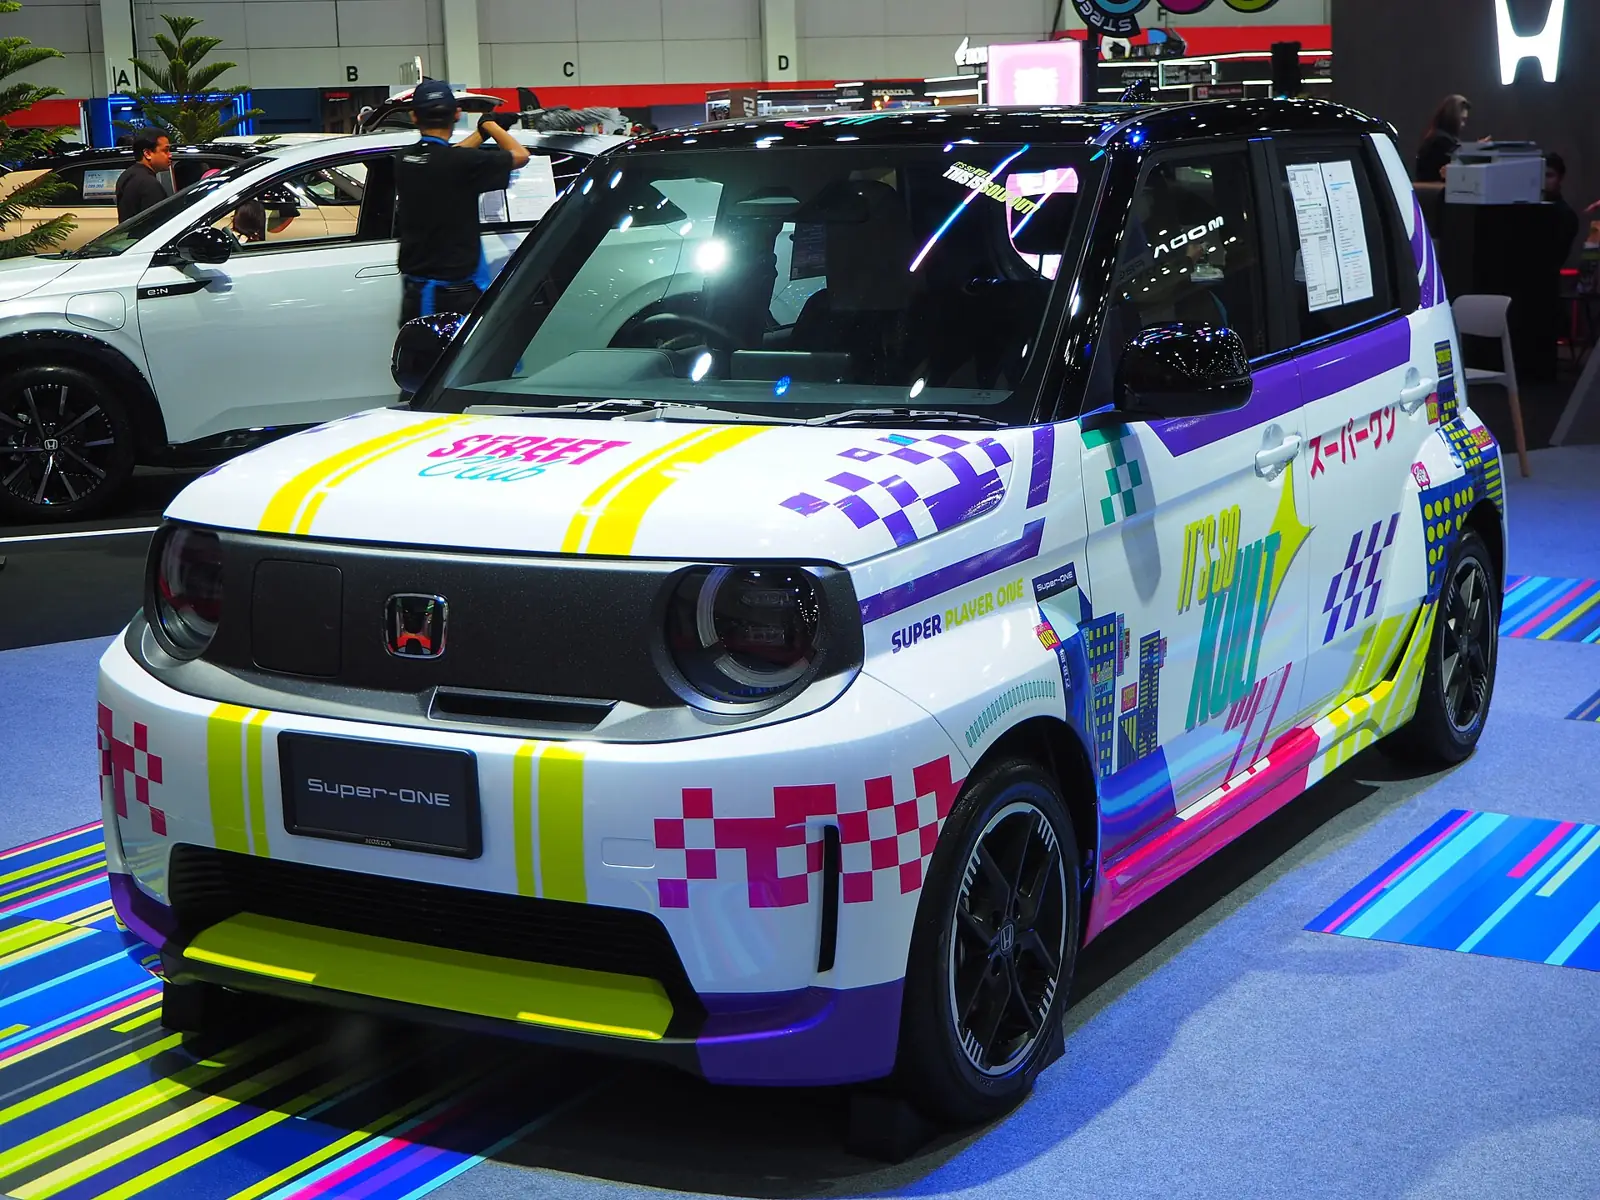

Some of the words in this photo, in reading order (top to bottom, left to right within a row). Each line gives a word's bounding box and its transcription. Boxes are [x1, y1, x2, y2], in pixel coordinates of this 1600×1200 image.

[1076, 0, 1132, 32] STRE
[346, 65, 358, 82] B
[563, 61, 574, 77] C
[778, 55, 789, 70] D
[116, 70, 131, 87] A
[871, 88, 916, 97] HONDA
[427, 434, 632, 466] STREET
[1308, 404, 1397, 481] スーパーワン
[418, 455, 562, 482] Club
[1176, 513, 1216, 616] IT'S
[1211, 503, 1241, 594] SO
[1036, 571, 1074, 592] Super-ONE
[891, 613, 942, 653] SUPER
[945, 591, 994, 631] PLAYER
[997, 577, 1024, 607] ONE
[1185, 530, 1282, 733] KULT
[307, 777, 451, 807] Super-ONE
[364, 836, 392, 847] HONDA
